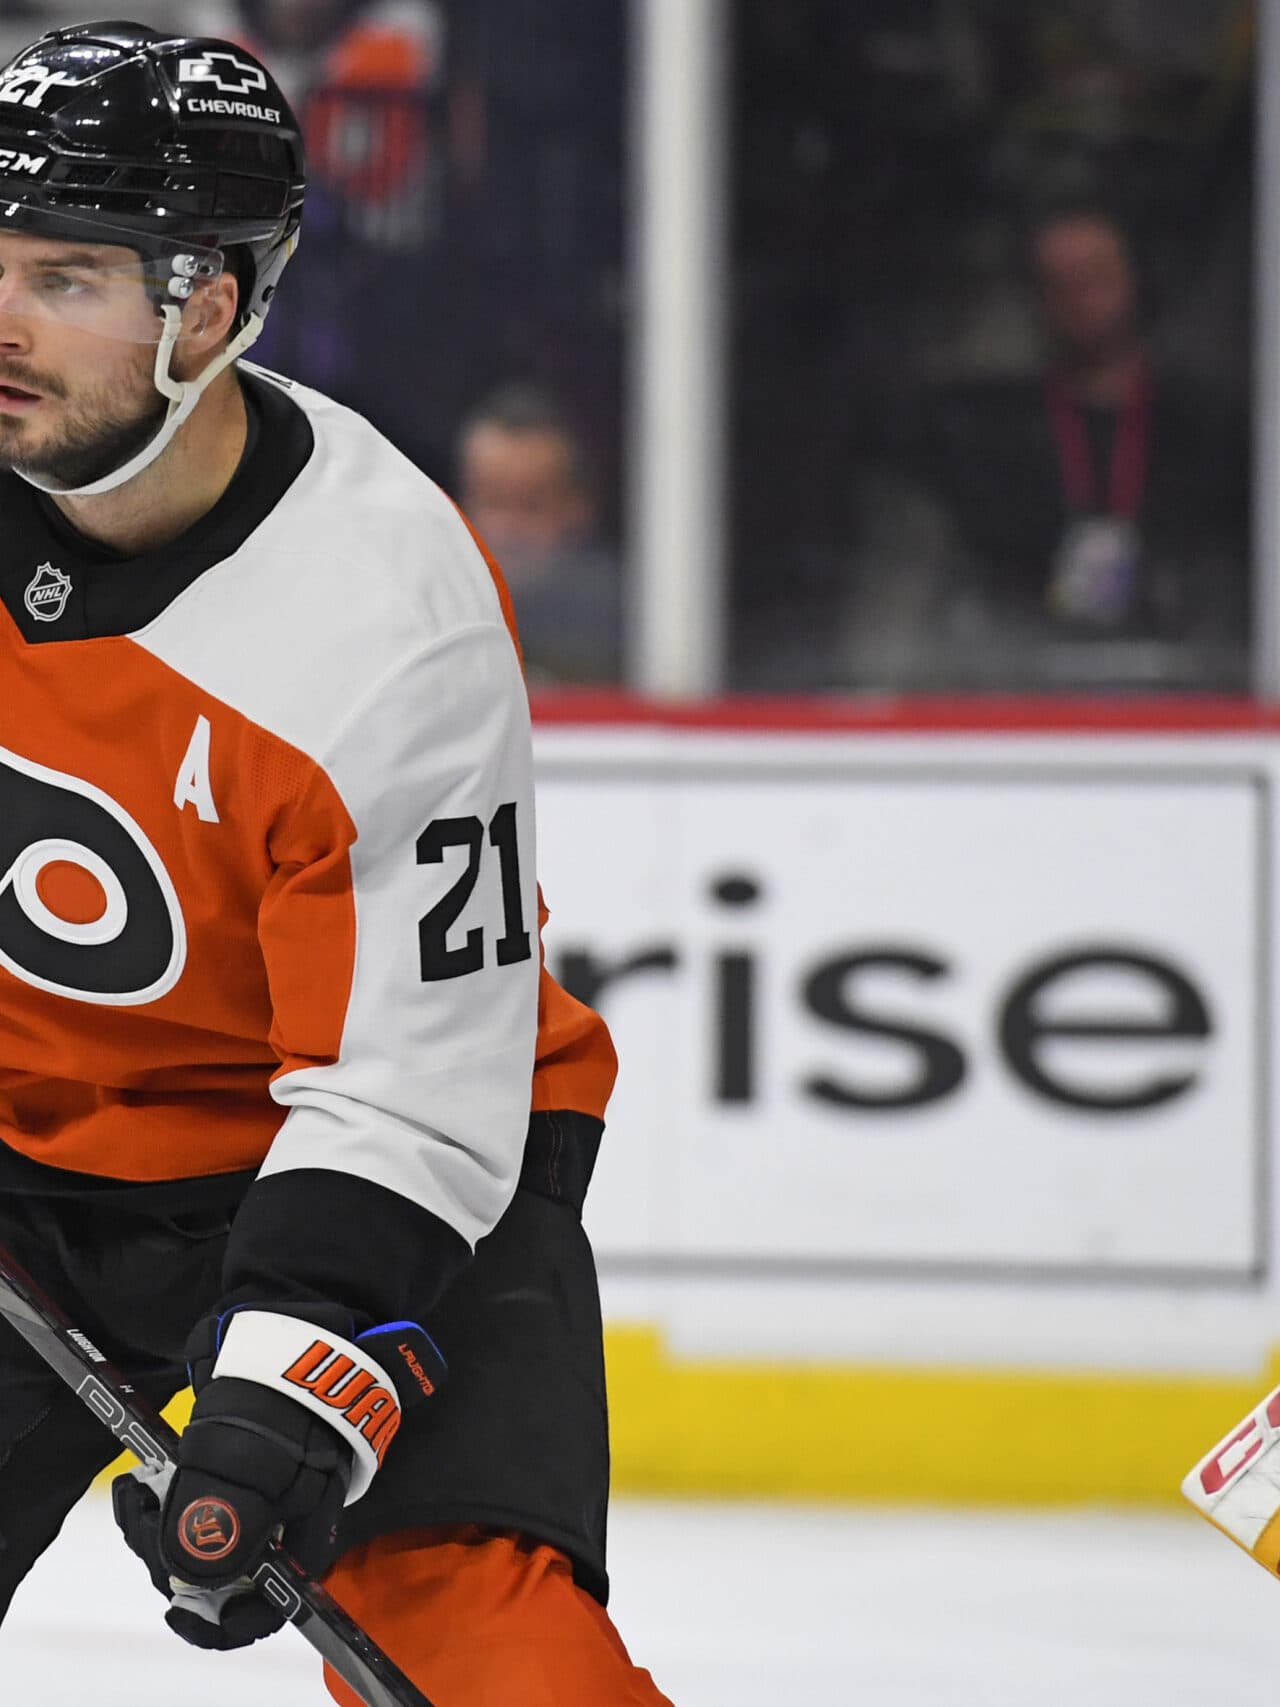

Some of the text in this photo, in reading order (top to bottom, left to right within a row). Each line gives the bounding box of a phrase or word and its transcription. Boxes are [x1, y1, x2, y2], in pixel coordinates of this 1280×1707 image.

[187, 98, 281, 124] CHEVROLET
[31, 586, 62, 602] NHL
[174, 714, 220, 823] A
[416, 801, 532, 982] 21
[66, 1328, 107, 1362] LAUGHTON
